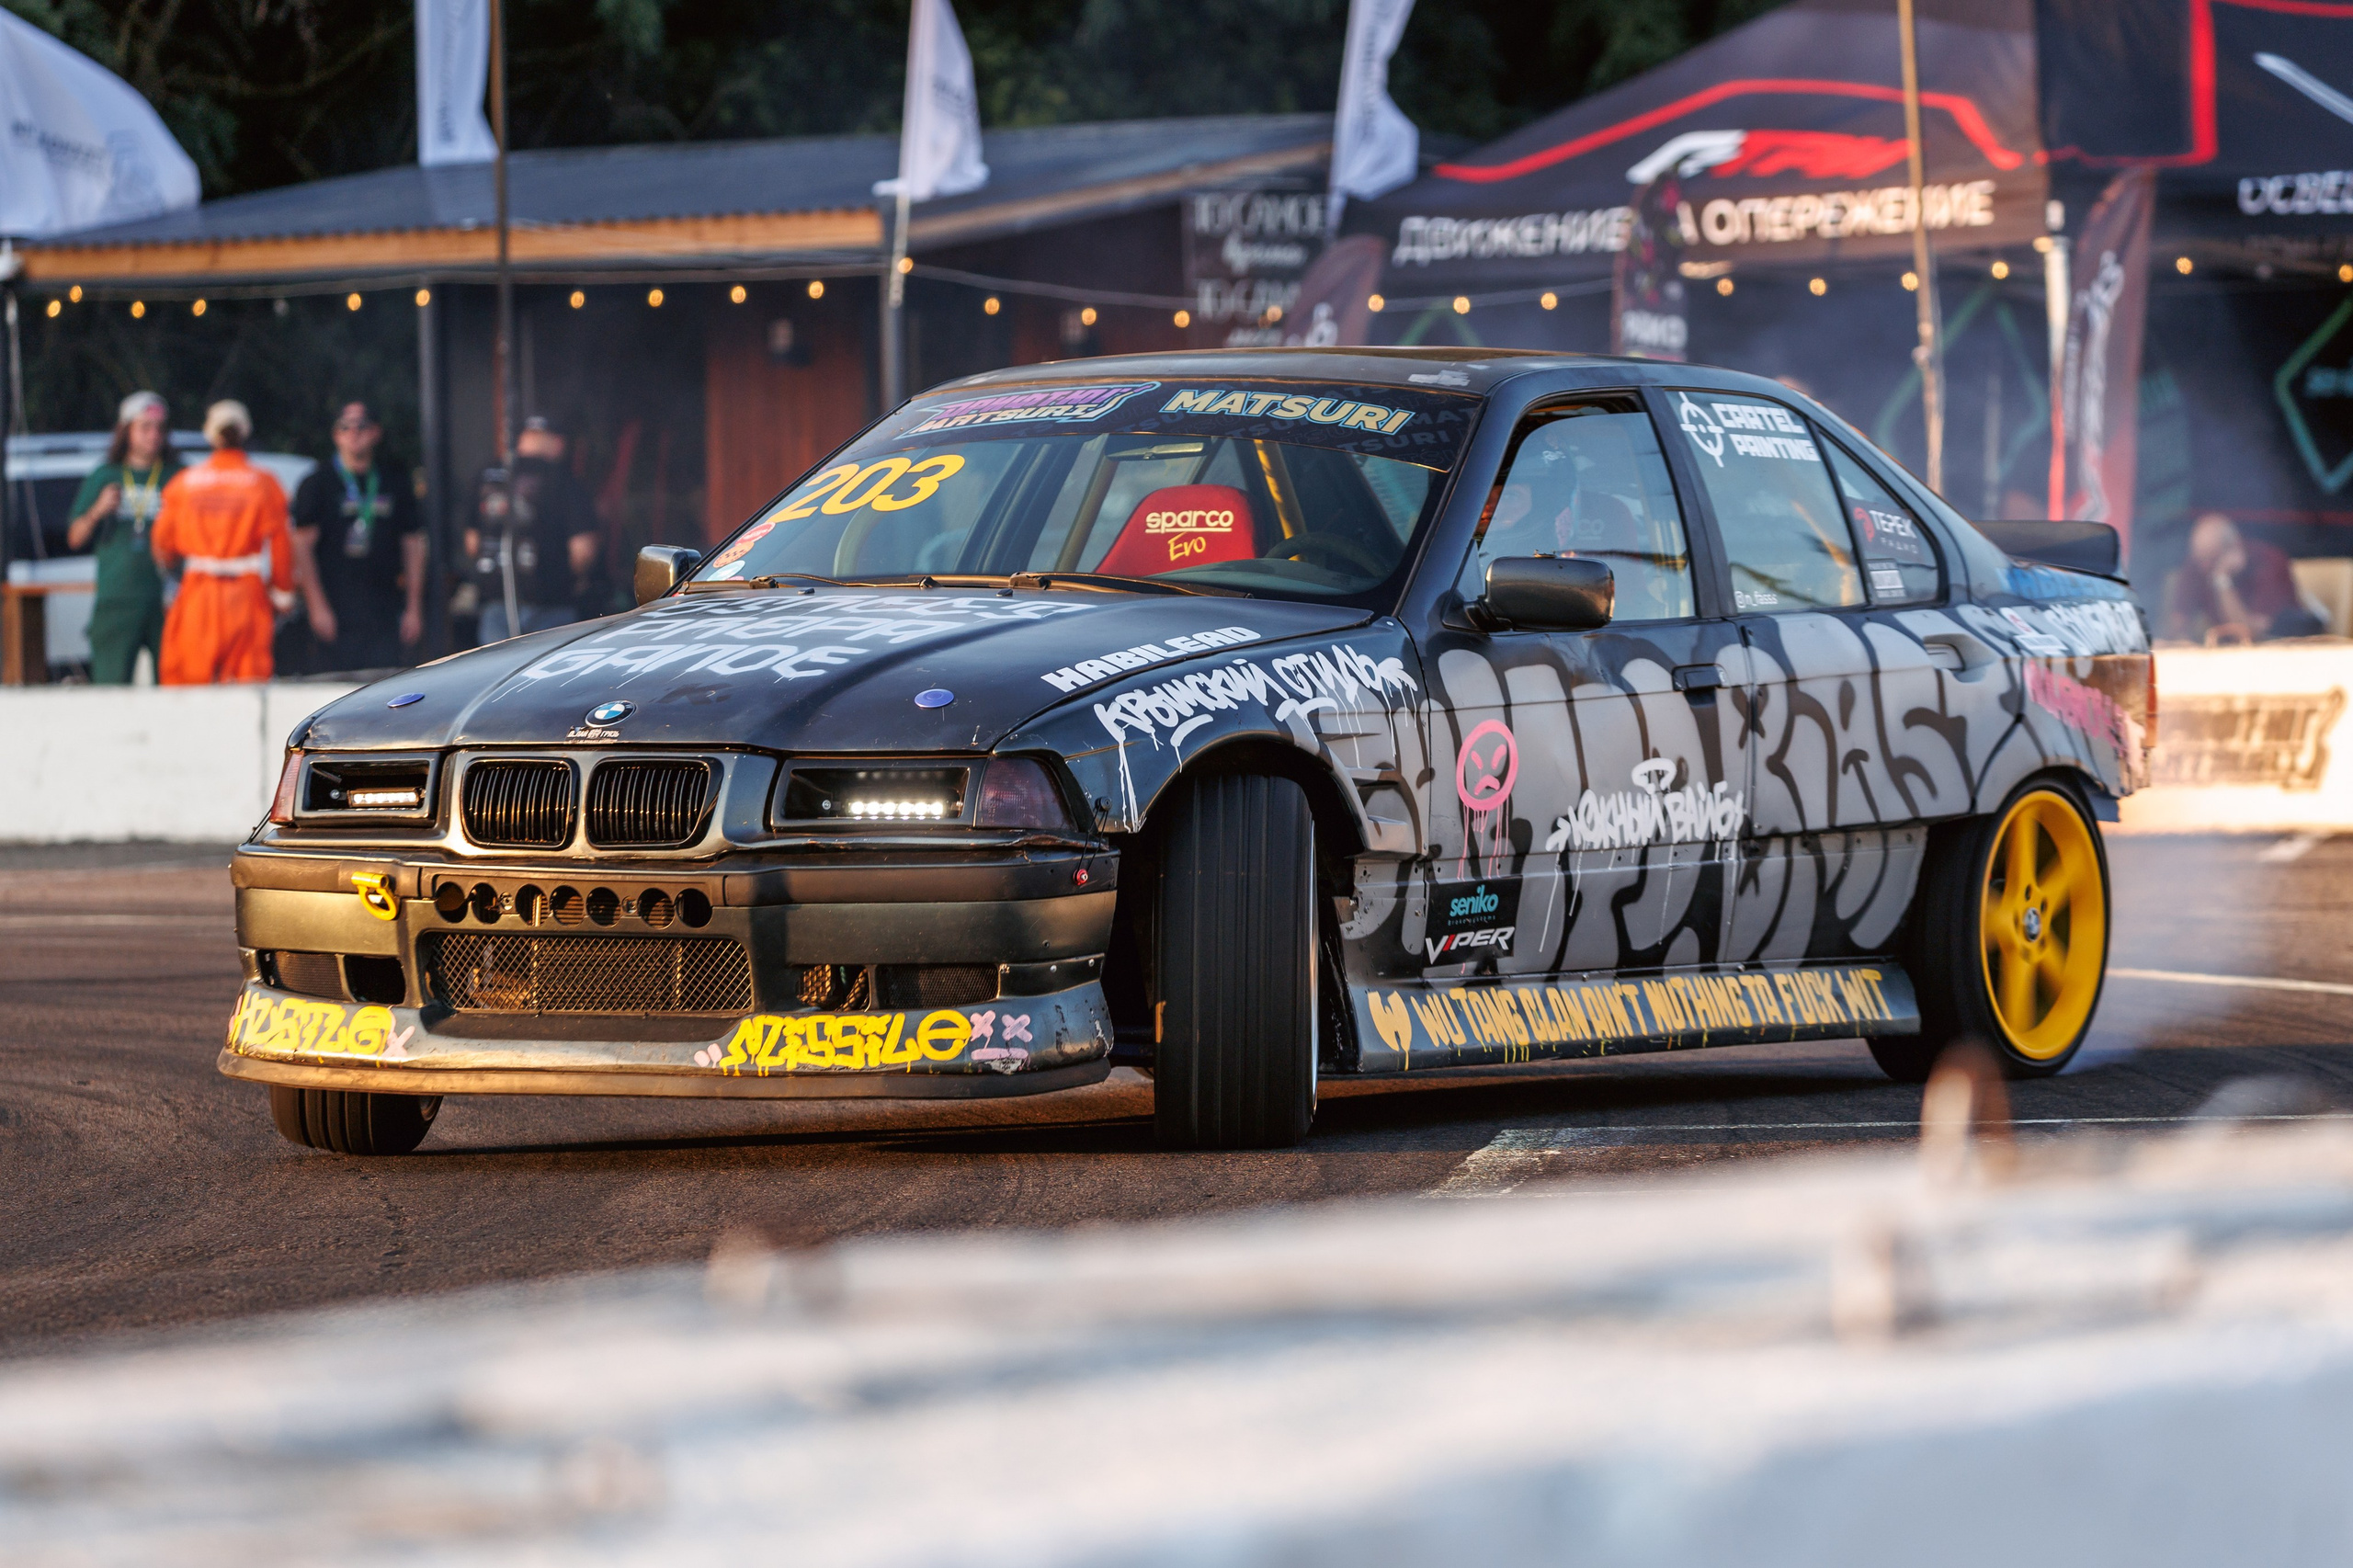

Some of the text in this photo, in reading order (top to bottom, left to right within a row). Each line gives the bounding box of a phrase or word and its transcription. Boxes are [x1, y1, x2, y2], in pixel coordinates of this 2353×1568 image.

[1392, 207, 1631, 267] ДВИЖЕНИЕ
[1700, 180, 1995, 245] ОПЕРЕЖЕНИЕ
[909, 403, 1100, 434] MATSURI
[1161, 390, 1414, 435] MATSURI
[1711, 403, 1806, 434] CARTEL
[1729, 433, 1821, 461] PRINTING
[765, 454, 965, 524] 203
[1145, 510, 1234, 533] sparco
[1167, 532, 1207, 561] Evo
[1041, 627, 1261, 693] HABILEAD
[1449, 884, 1498, 916] seniko
[1426, 926, 1516, 965] VIPER
[1410, 994, 1467, 1048] WU
[1449, 987, 1529, 1046] TANG
[1518, 987, 1592, 1041] CLAN
[1643, 975, 1753, 1034] NUTHING
[1738, 974, 1784, 1025] TA
[1774, 971, 1847, 1025] FUCK
[1835, 969, 1893, 1020] WIT
